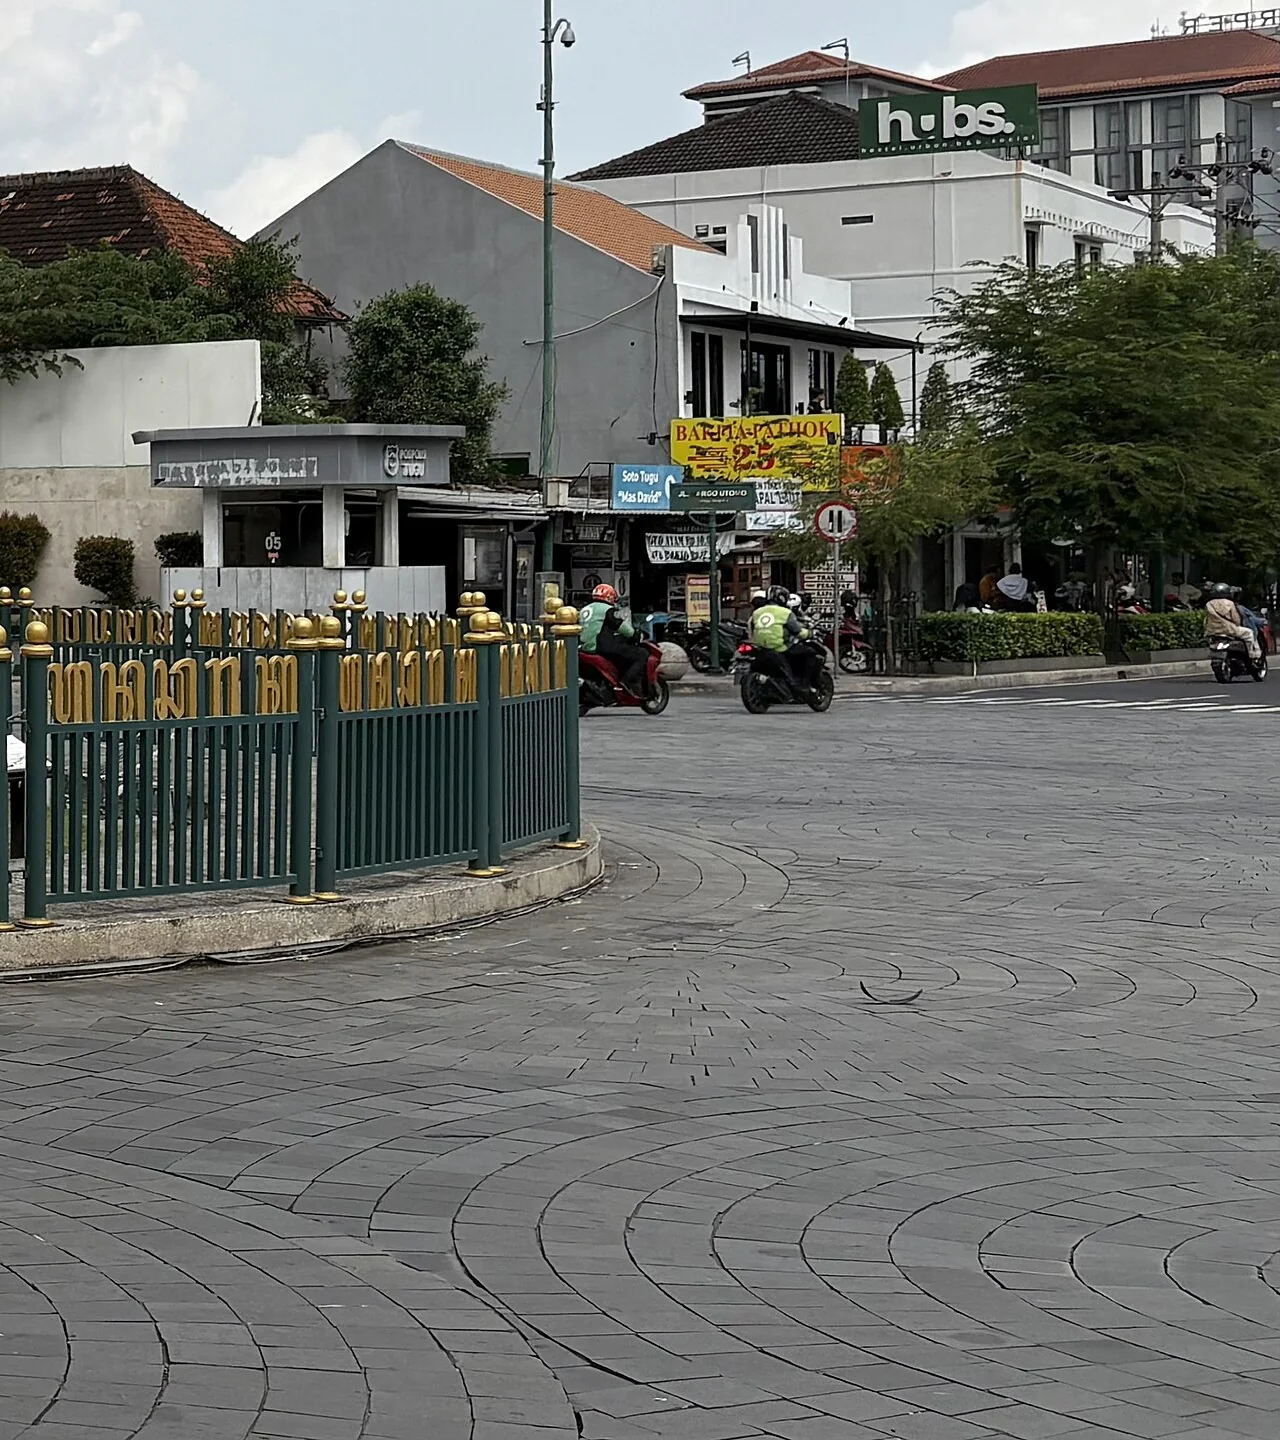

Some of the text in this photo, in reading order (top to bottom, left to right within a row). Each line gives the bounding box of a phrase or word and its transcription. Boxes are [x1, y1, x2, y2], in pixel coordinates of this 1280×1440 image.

[732, 443, 775, 471] 25
[622, 470, 659, 485] Soto Tugu
[265, 536, 282, 550] 05
